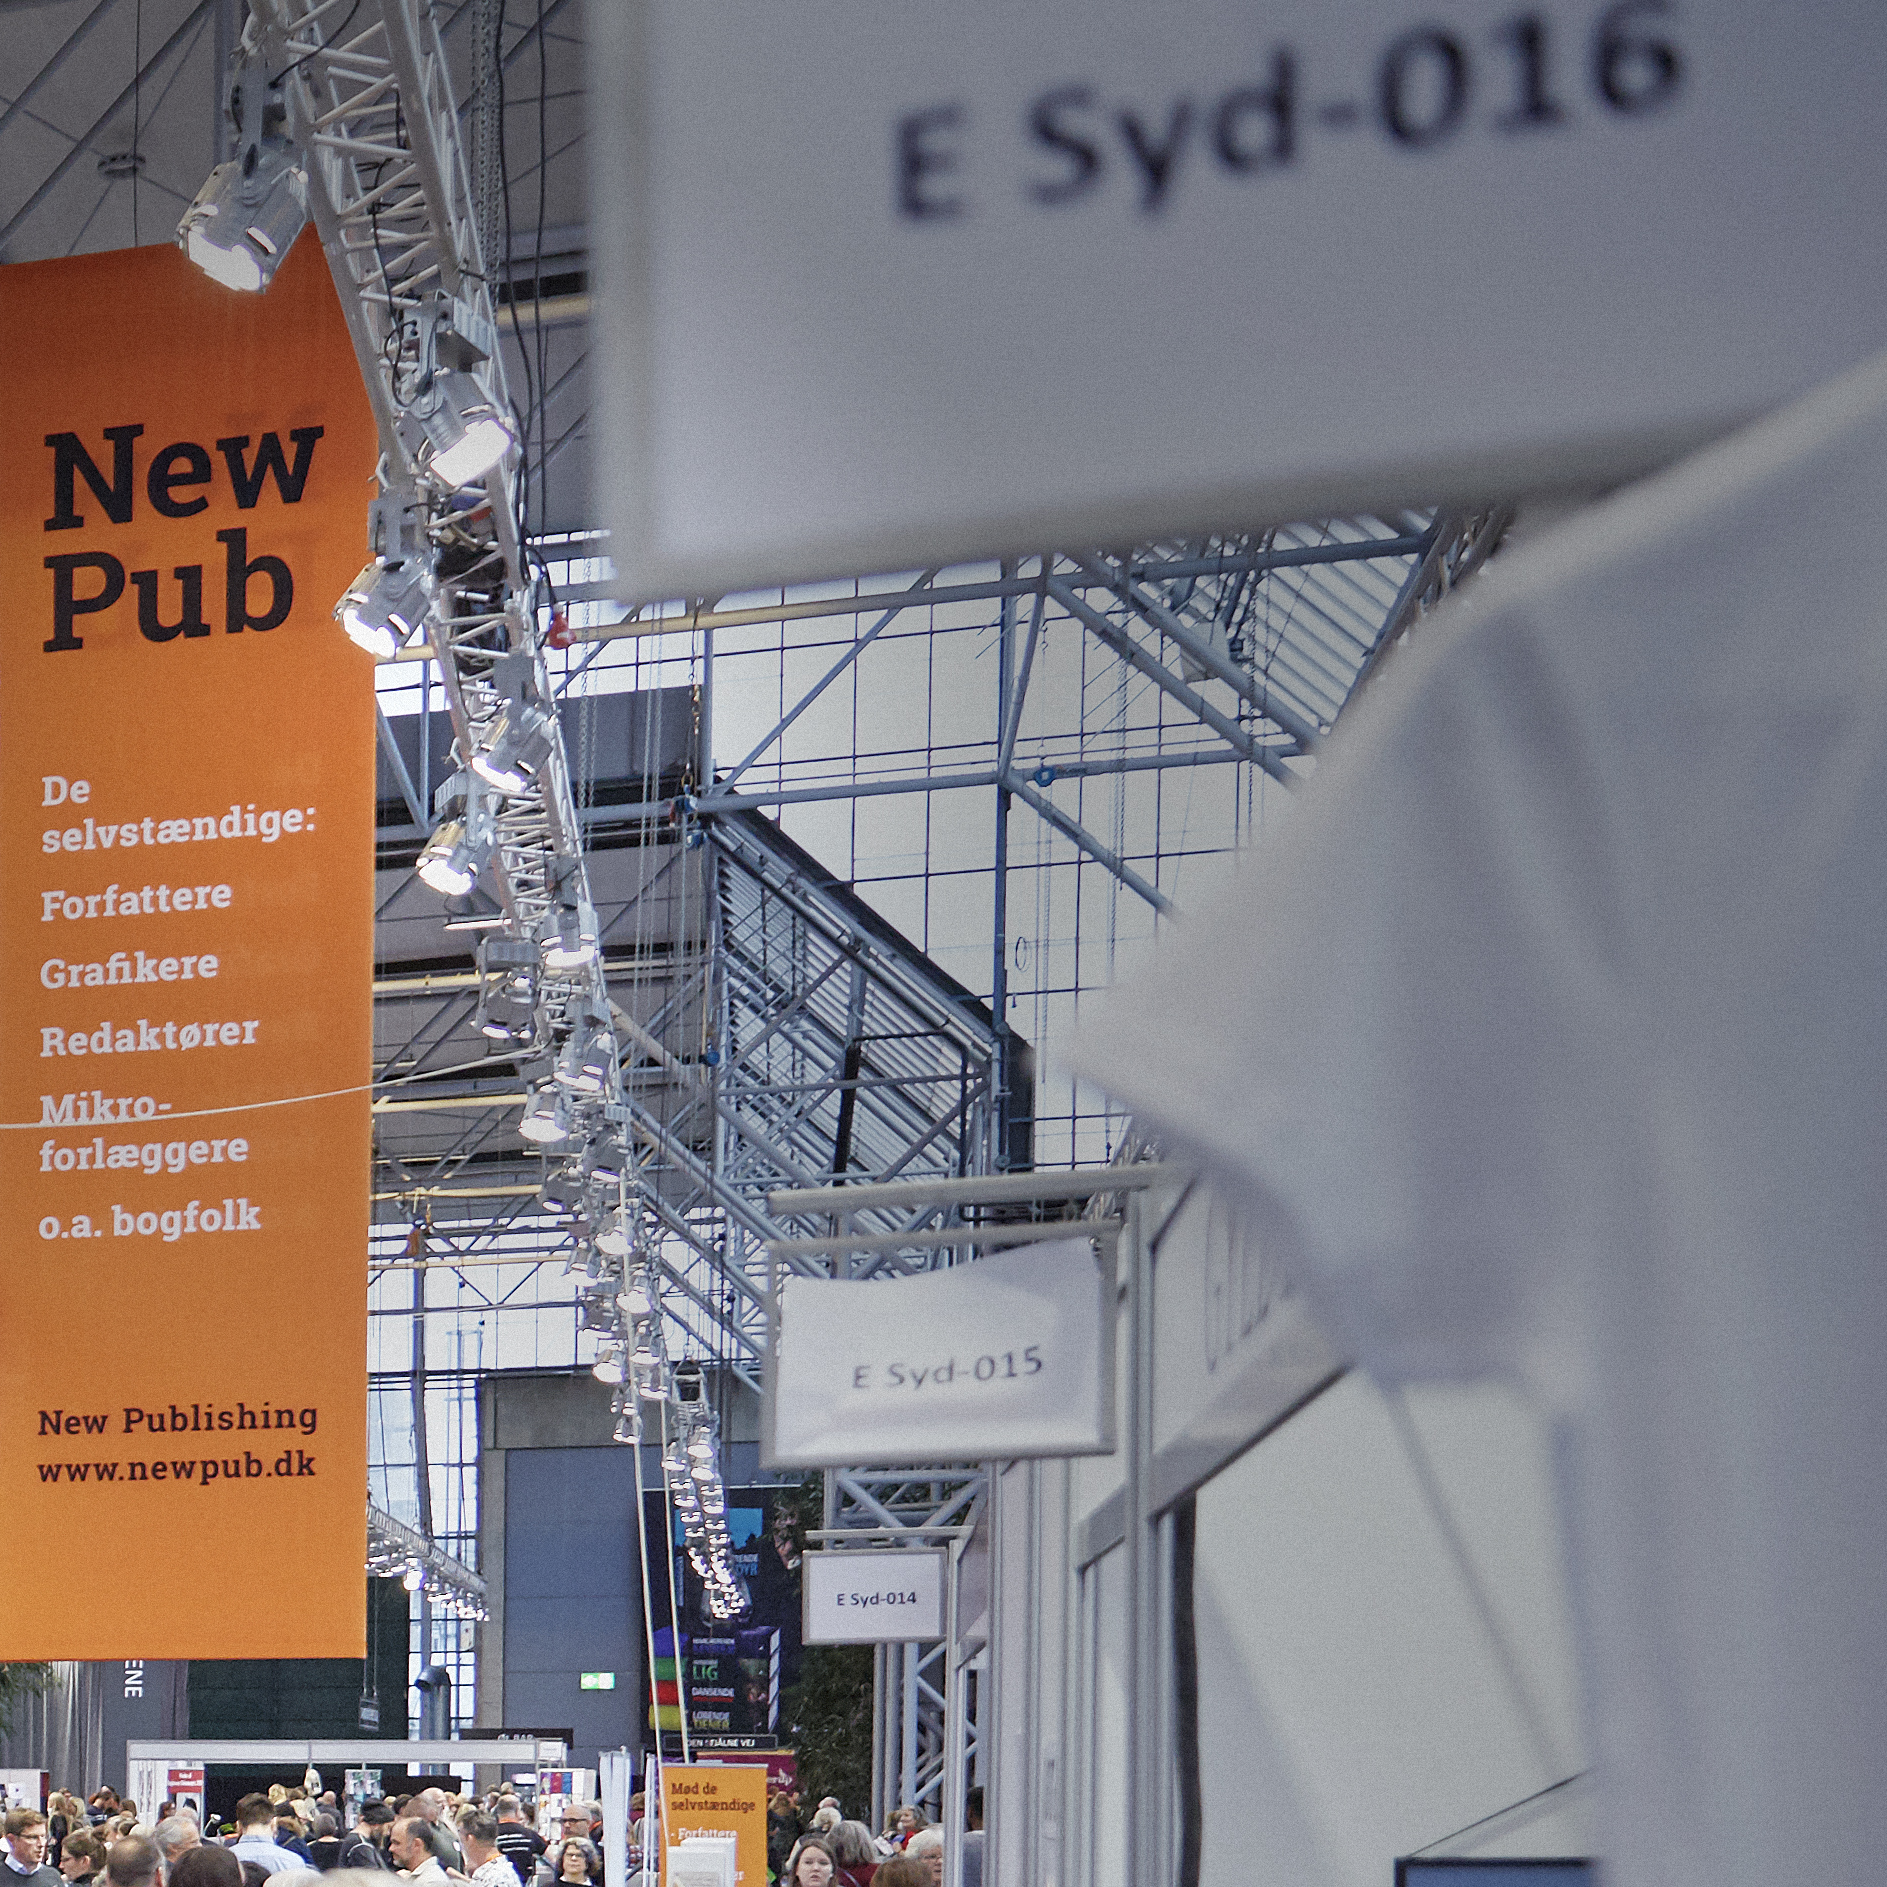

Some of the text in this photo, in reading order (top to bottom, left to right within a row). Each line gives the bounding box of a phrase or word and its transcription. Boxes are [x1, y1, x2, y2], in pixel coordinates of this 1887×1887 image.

[894, 1, 1687, 221] E Syd-016
[43, 424, 324, 532] New
[43, 527, 294, 653] Pub
[41, 775, 91, 806] De
[41, 804, 316, 853] selvstændige:
[41, 884, 233, 922] Forfattere
[40, 951, 219, 989] Grafikere
[40, 1018, 260, 1058] Redaktører
[39, 1090, 172, 1126] Mikro-
[39, 1137, 249, 1175] forlæggere
[38, 1198, 262, 1242] o.a. bogfolk
[853, 1344, 1043, 1392] E Syd-015
[37, 1402, 318, 1436] New Publishing
[37, 1450, 317, 1486] www.newpub.dk
[836, 1590, 918, 1609] E Syd-014
[671, 1782, 718, 1795] Mød de
[671, 1798, 756, 1813] selvstændige
